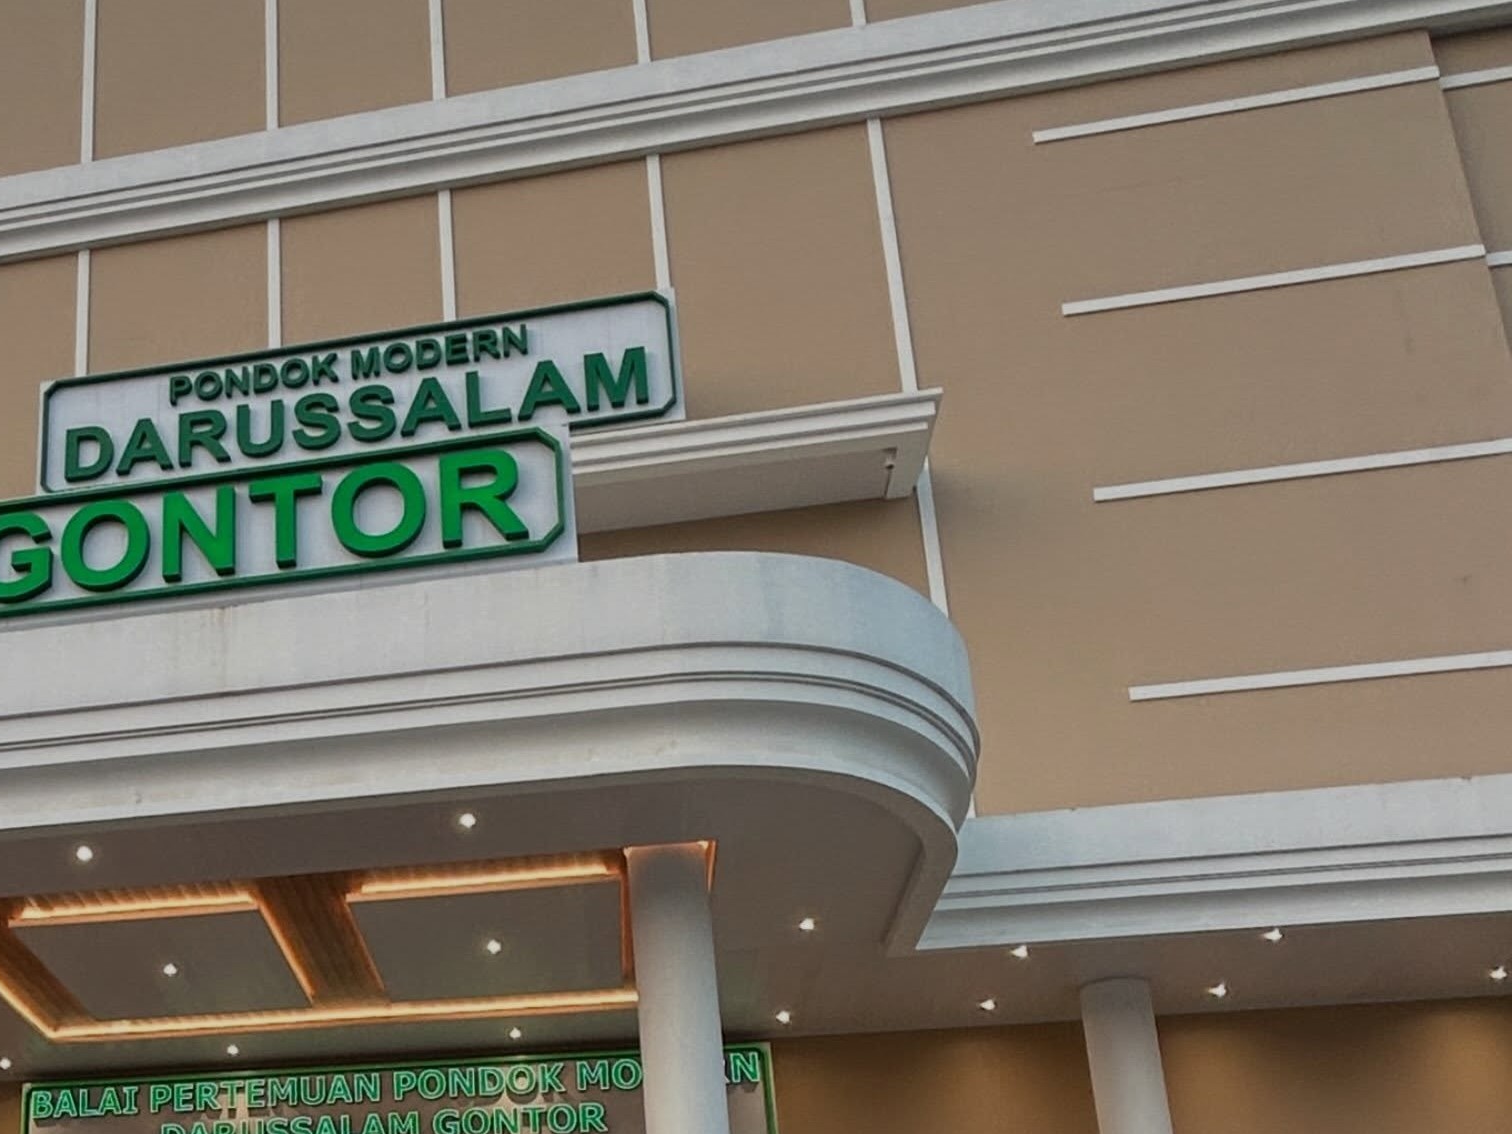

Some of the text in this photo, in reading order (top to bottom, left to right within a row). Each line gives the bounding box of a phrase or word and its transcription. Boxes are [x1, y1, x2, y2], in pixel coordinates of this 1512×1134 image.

[169, 323, 529, 406] PONDOK MODERN
[64, 345, 650, 483] DARUSSALAM
[31, 1051, 761, 1120] BALAI PERTEMUAN PONDOK MON
